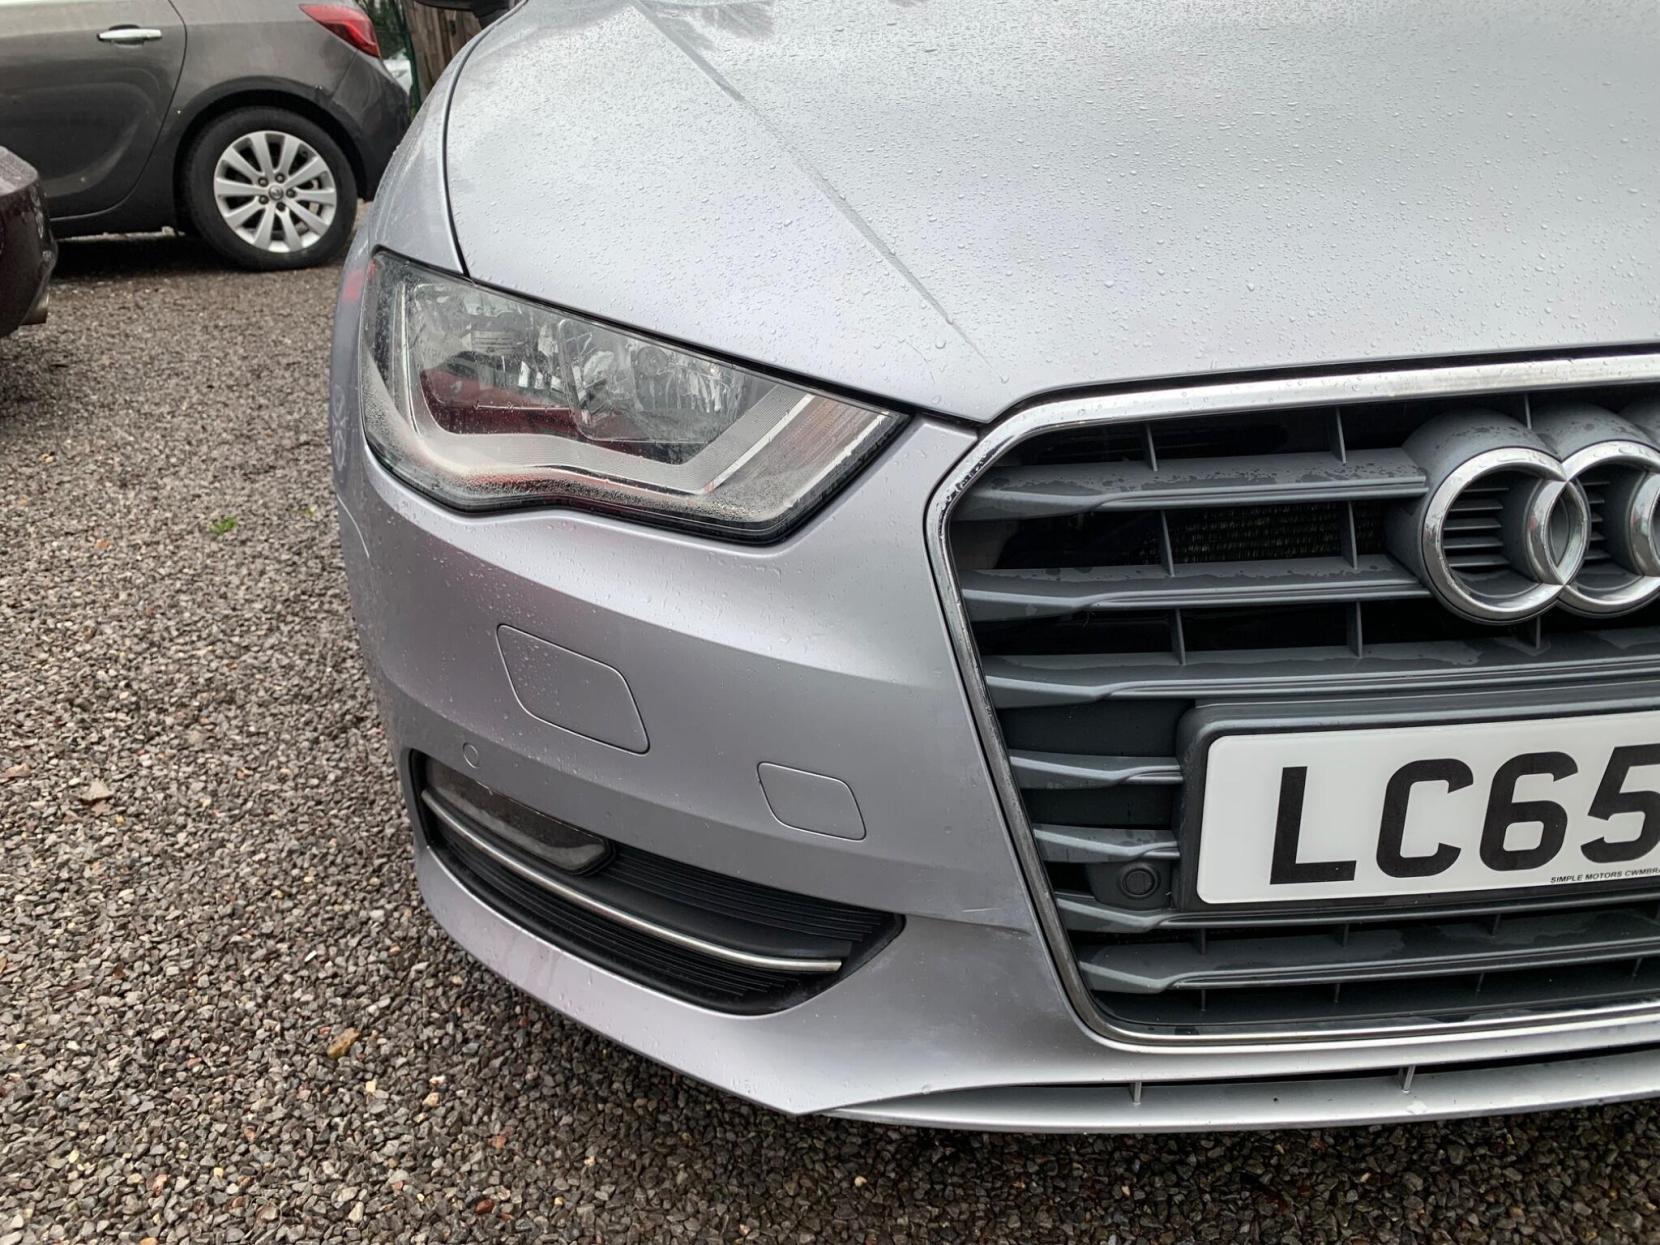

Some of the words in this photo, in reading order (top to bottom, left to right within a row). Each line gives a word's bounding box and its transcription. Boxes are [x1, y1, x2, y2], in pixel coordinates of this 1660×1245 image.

[1270, 743, 1660, 884] LC65
[1550, 874, 1583, 884] SIMPLE
[1585, 871, 1622, 881] MOTORS
